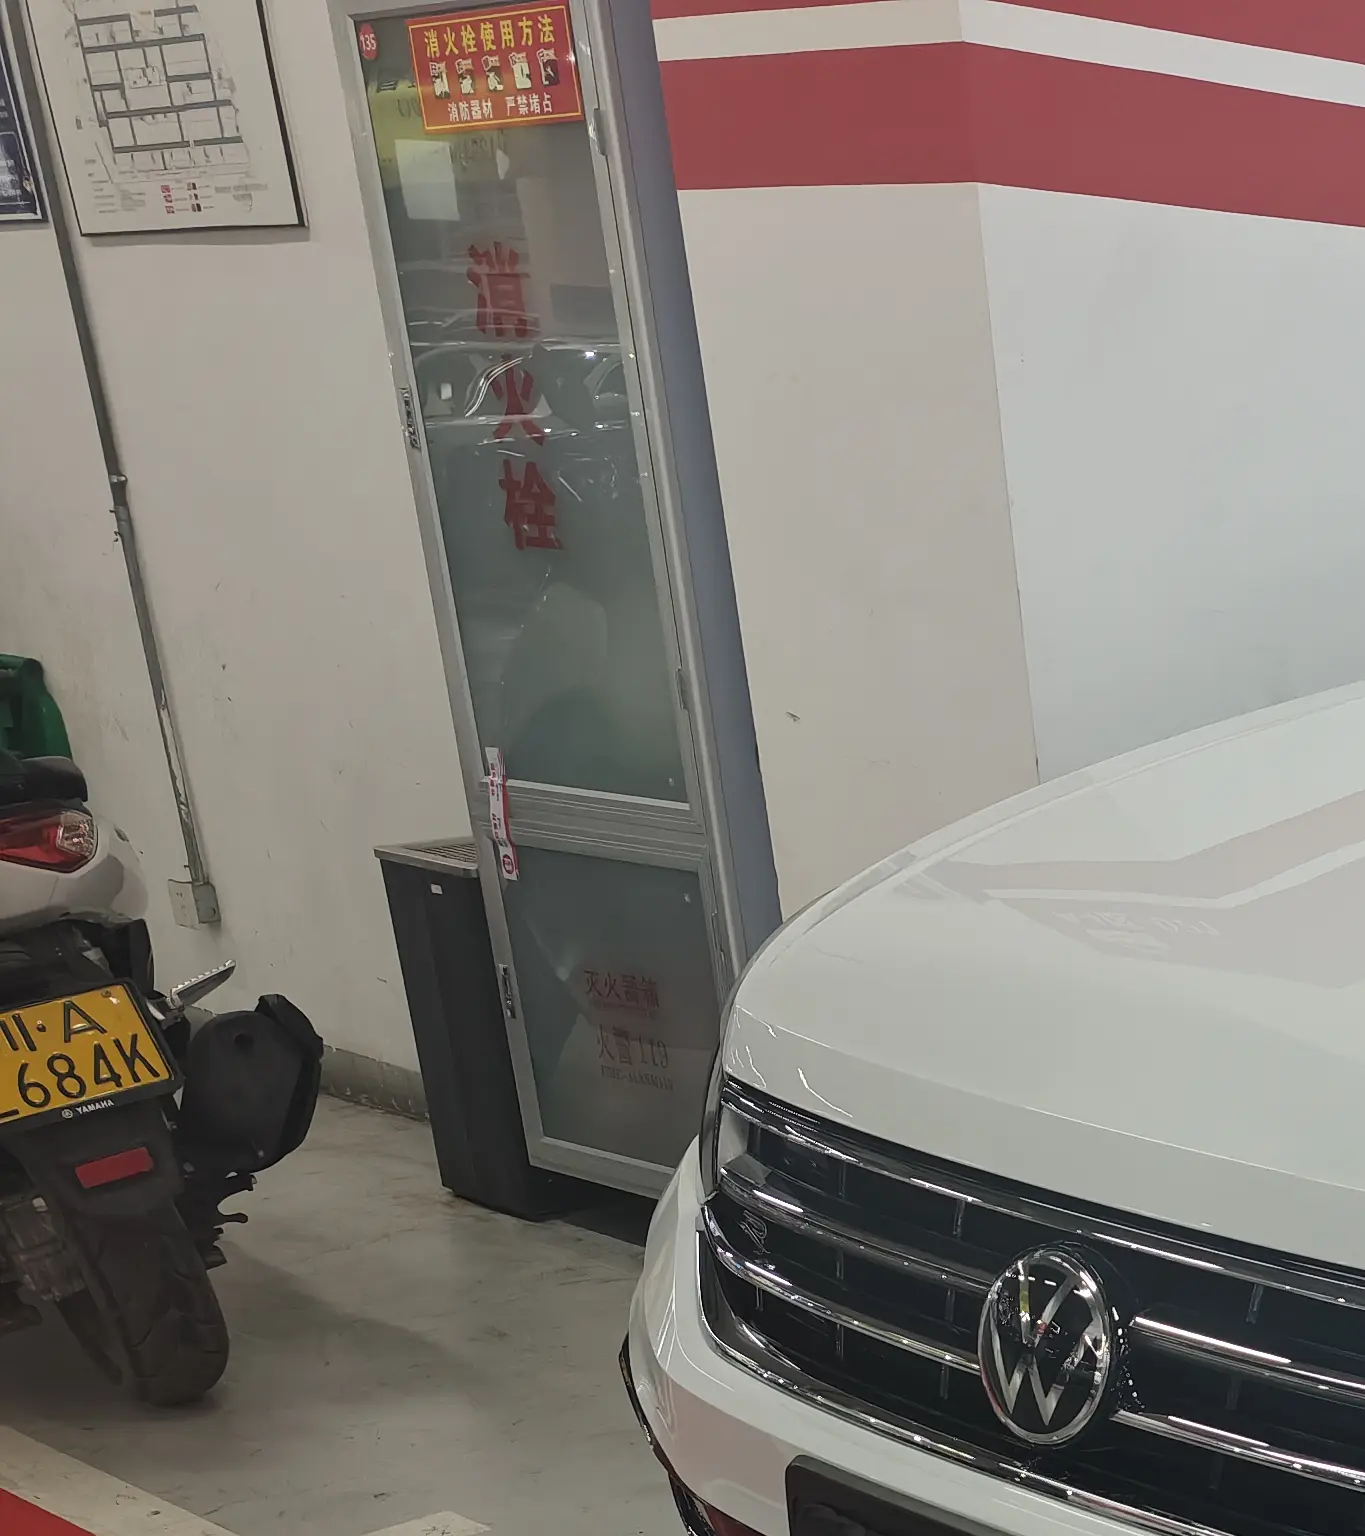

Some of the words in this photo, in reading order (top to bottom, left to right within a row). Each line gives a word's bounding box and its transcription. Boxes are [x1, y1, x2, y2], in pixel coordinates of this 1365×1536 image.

[360, 33, 377, 51] 135
[424, 14, 556, 58] 消火栓使用方法
[447, 98, 494, 122] 消防器材
[505, 92, 553, 117] 严禁堵占
[467, 242, 563, 550] 消火栓
[75, 1099, 115, 1115] YAMAHA
